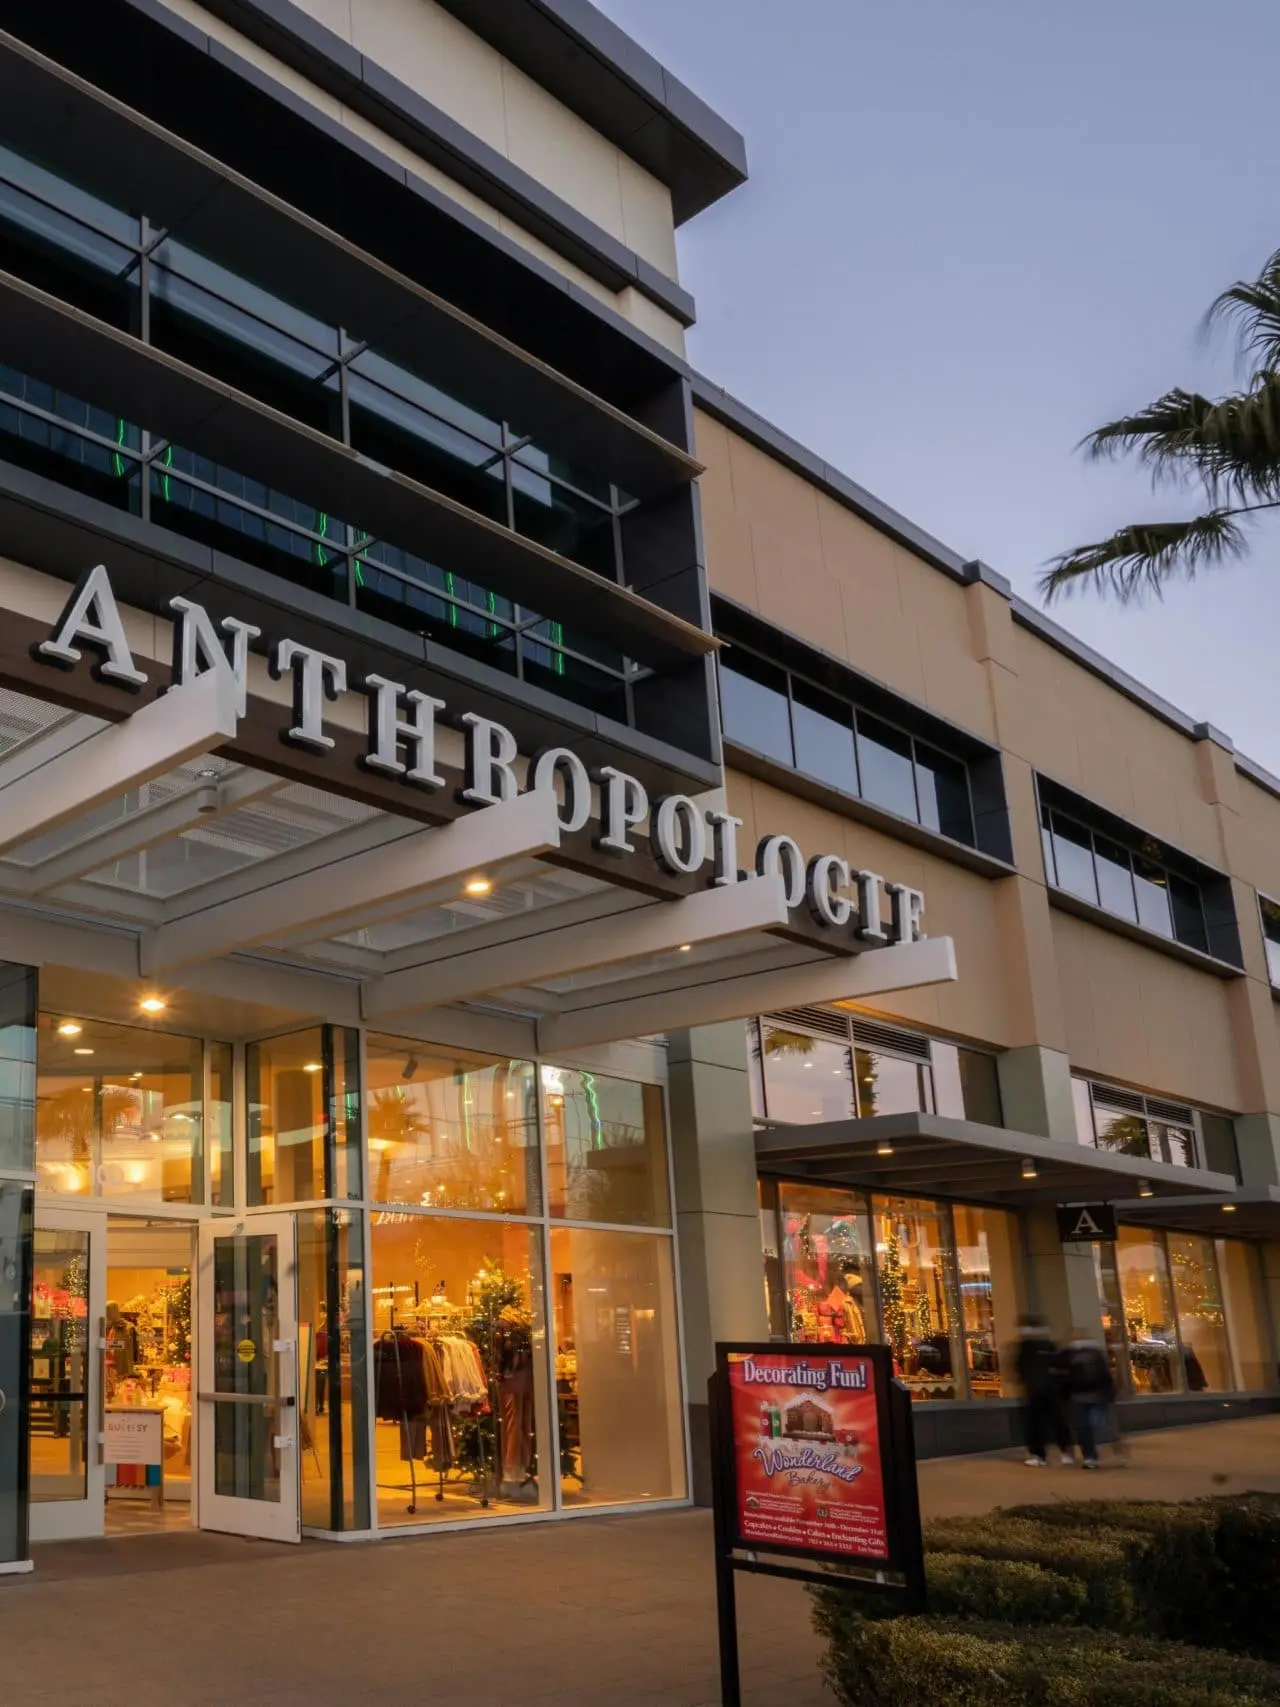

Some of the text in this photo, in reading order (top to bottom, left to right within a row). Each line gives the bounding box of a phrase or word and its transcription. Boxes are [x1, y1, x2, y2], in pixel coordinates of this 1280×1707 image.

[37, 563, 928, 946] ANTHROPOLOGIE
[1071, 1208, 1104, 1233] A
[743, 1359, 867, 1391] Decorating Fun!
[752, 1447, 864, 1482] Wonderland
[785, 1470, 832, 1493] Bakery
